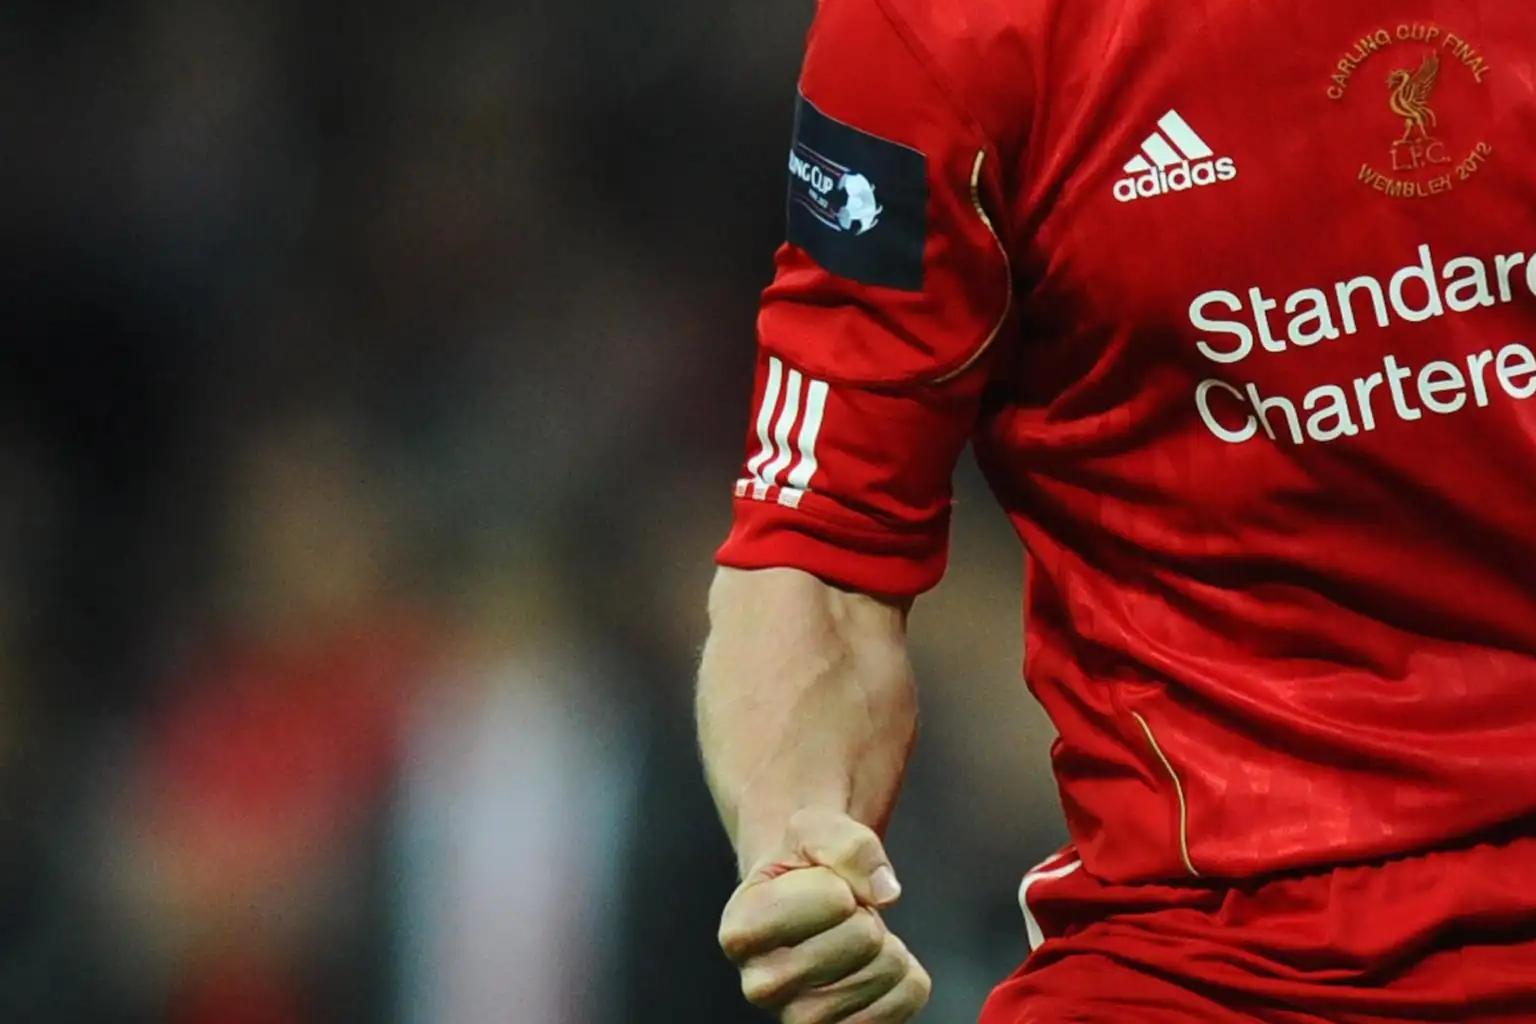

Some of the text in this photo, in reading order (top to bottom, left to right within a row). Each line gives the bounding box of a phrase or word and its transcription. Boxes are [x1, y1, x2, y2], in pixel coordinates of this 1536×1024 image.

[1327, 24, 1489, 99] CARLING CUP FINAL
[1113, 157, 1237, 202] adidas
[1358, 142, 1492, 197] WEMBLEY 2012
